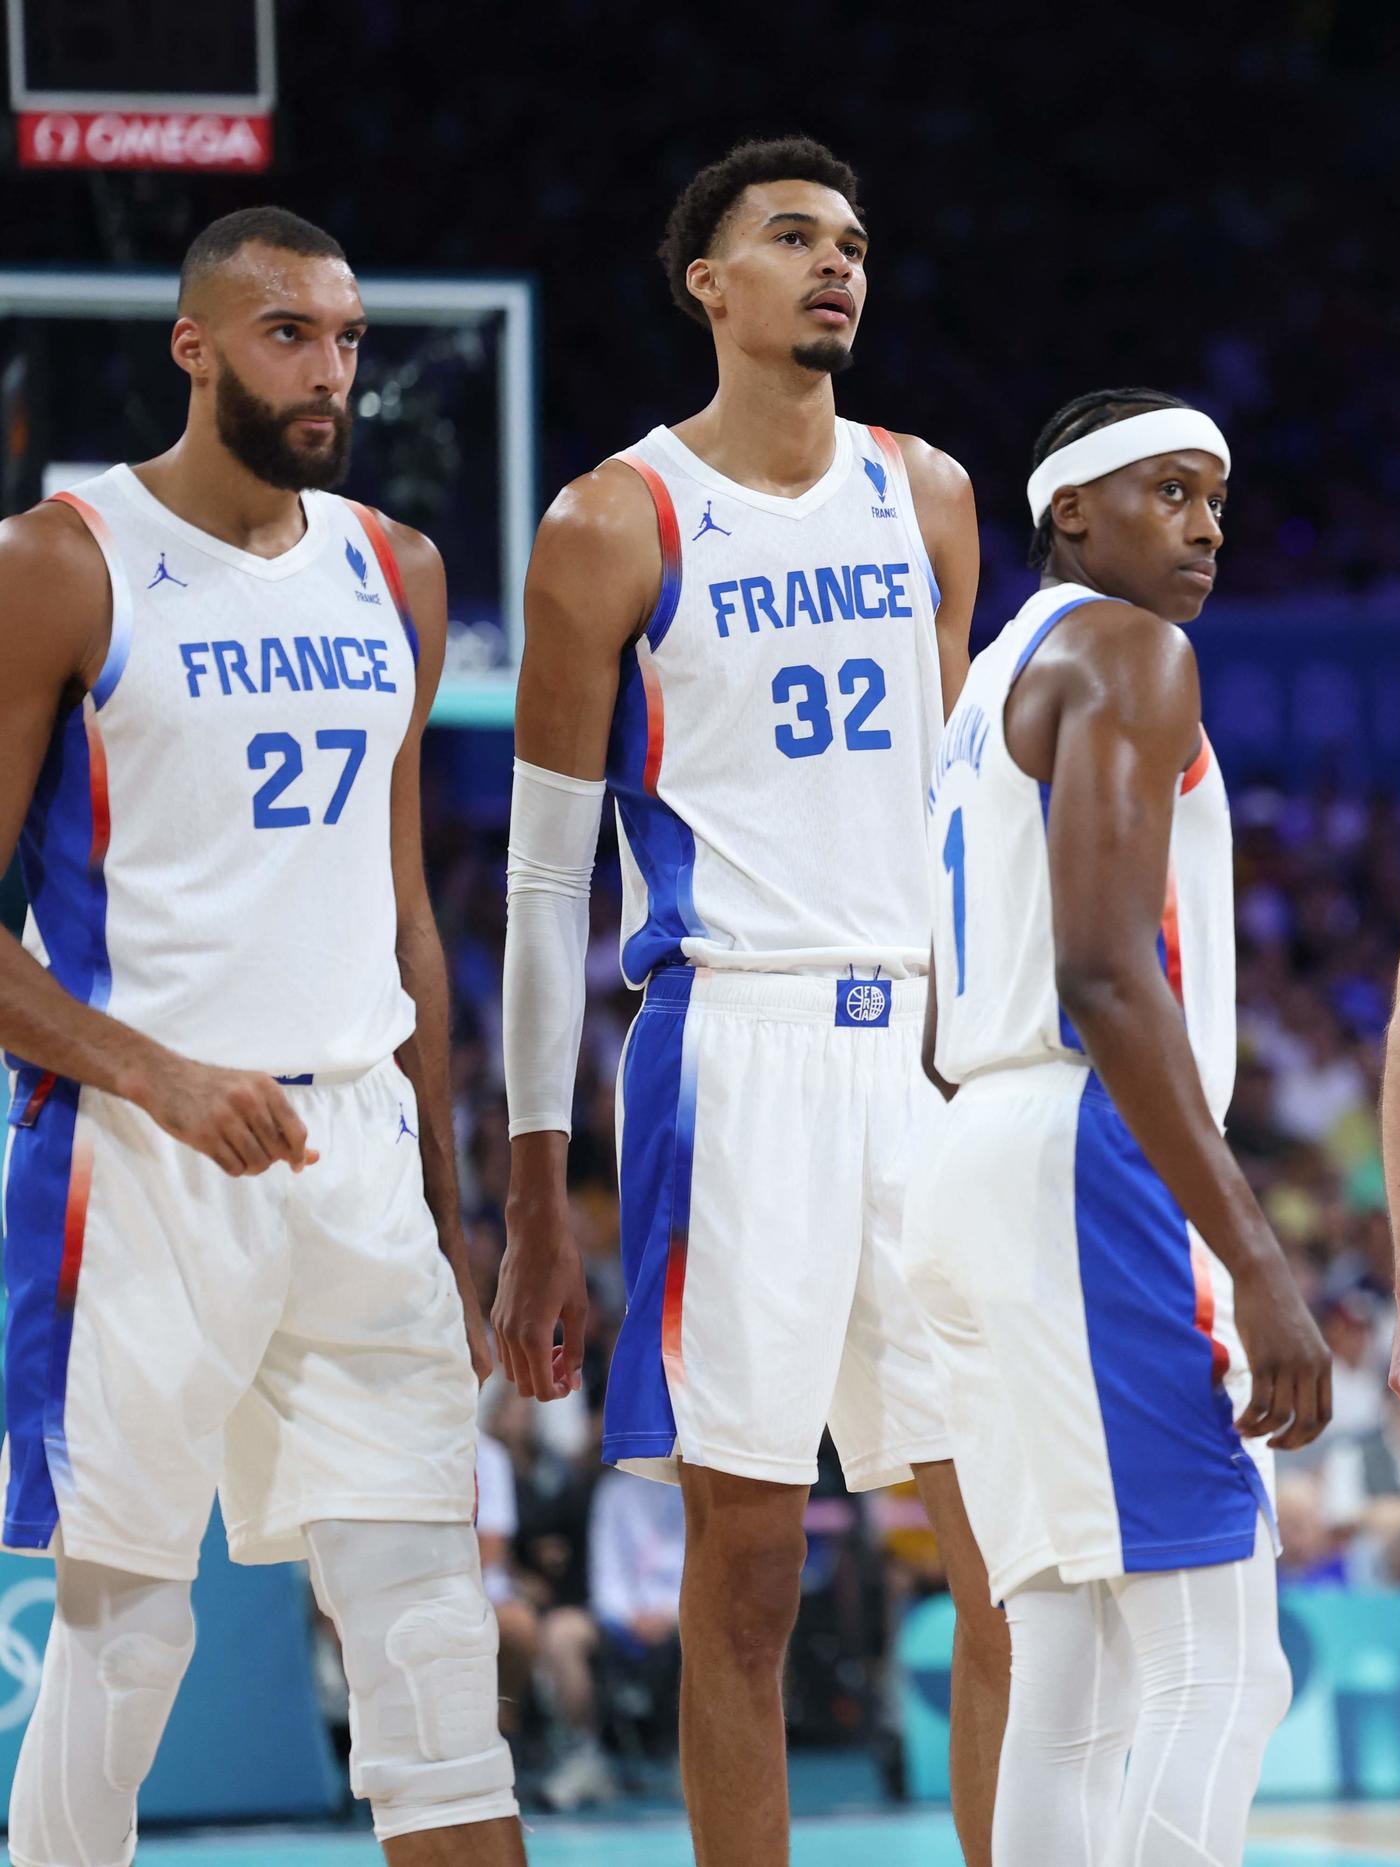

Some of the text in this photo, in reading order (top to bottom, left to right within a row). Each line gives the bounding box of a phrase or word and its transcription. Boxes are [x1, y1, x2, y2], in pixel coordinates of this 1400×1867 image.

[85, 112, 263, 165] OMEGA
[709, 563, 912, 638] FRANCE
[179, 636, 397, 698] FRANCE
[771, 658, 892, 759] 32
[247, 729, 367, 829] 27
[943, 806, 966, 998] 1
[861, 986, 871, 1021] FRA
